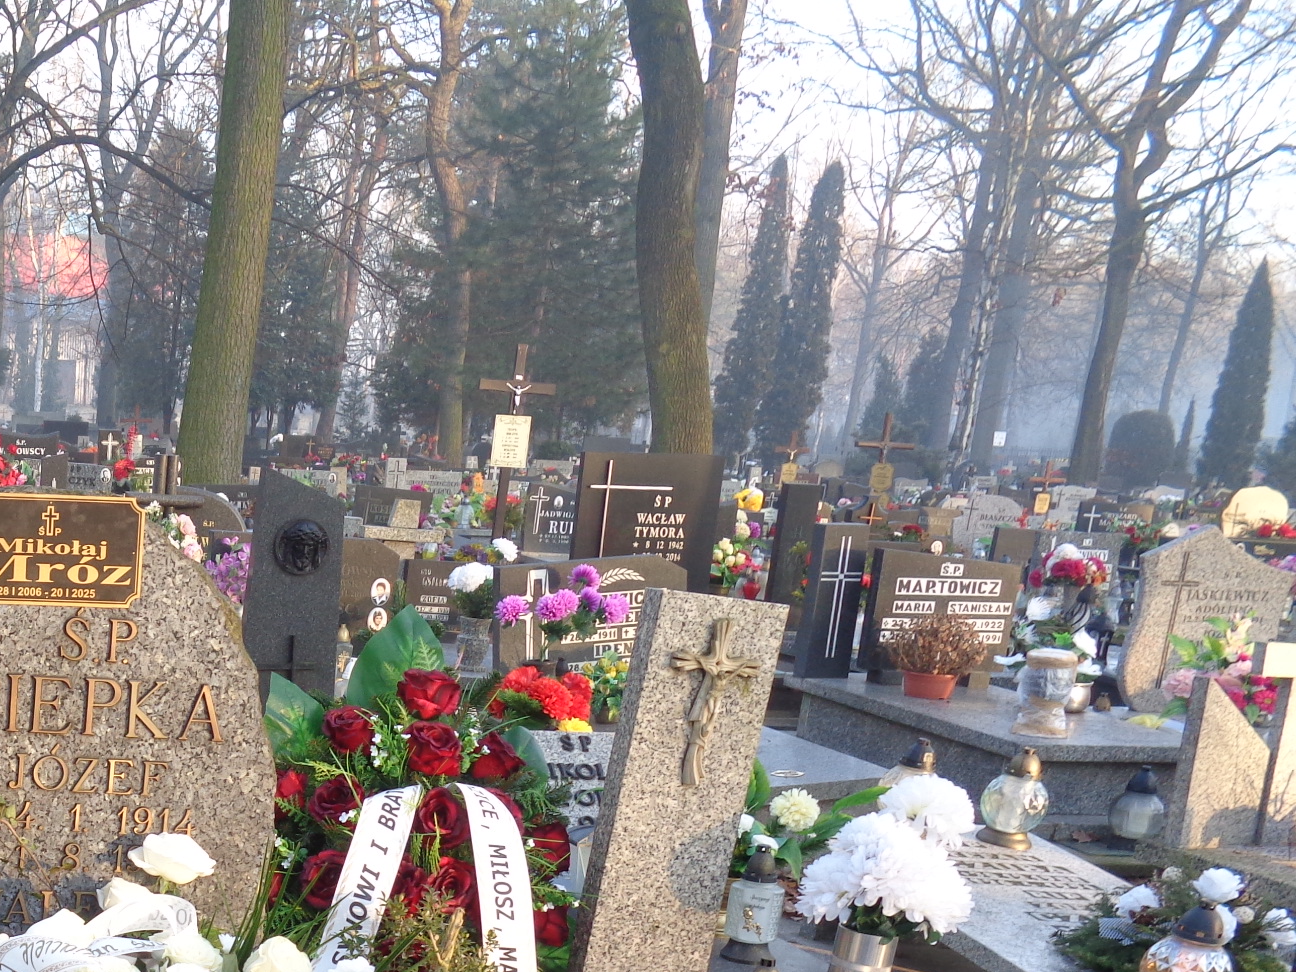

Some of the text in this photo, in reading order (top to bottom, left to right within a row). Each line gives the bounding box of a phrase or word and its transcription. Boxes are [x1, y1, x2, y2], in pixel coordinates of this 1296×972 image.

[636, 512, 686, 525] WACŁAW
[634, 527, 685, 539] TYMORA
[668, 541, 684, 550] 1942
[17, 587, 42, 597] 2006
[50, 588, 63, 597] 20
[71, 588, 96, 599] 2025
[897, 579, 1000, 595] MARTOWICZ
[894, 602, 1012, 614] MARIA STANISŁAW
[59, 608, 138, 664] Ś.P.
[598, 630, 616, 639] 1911
[595, 642, 634, 656] IREN
[7, 744, 172, 797] JÓZEF
[117, 806, 196, 836] 1914
